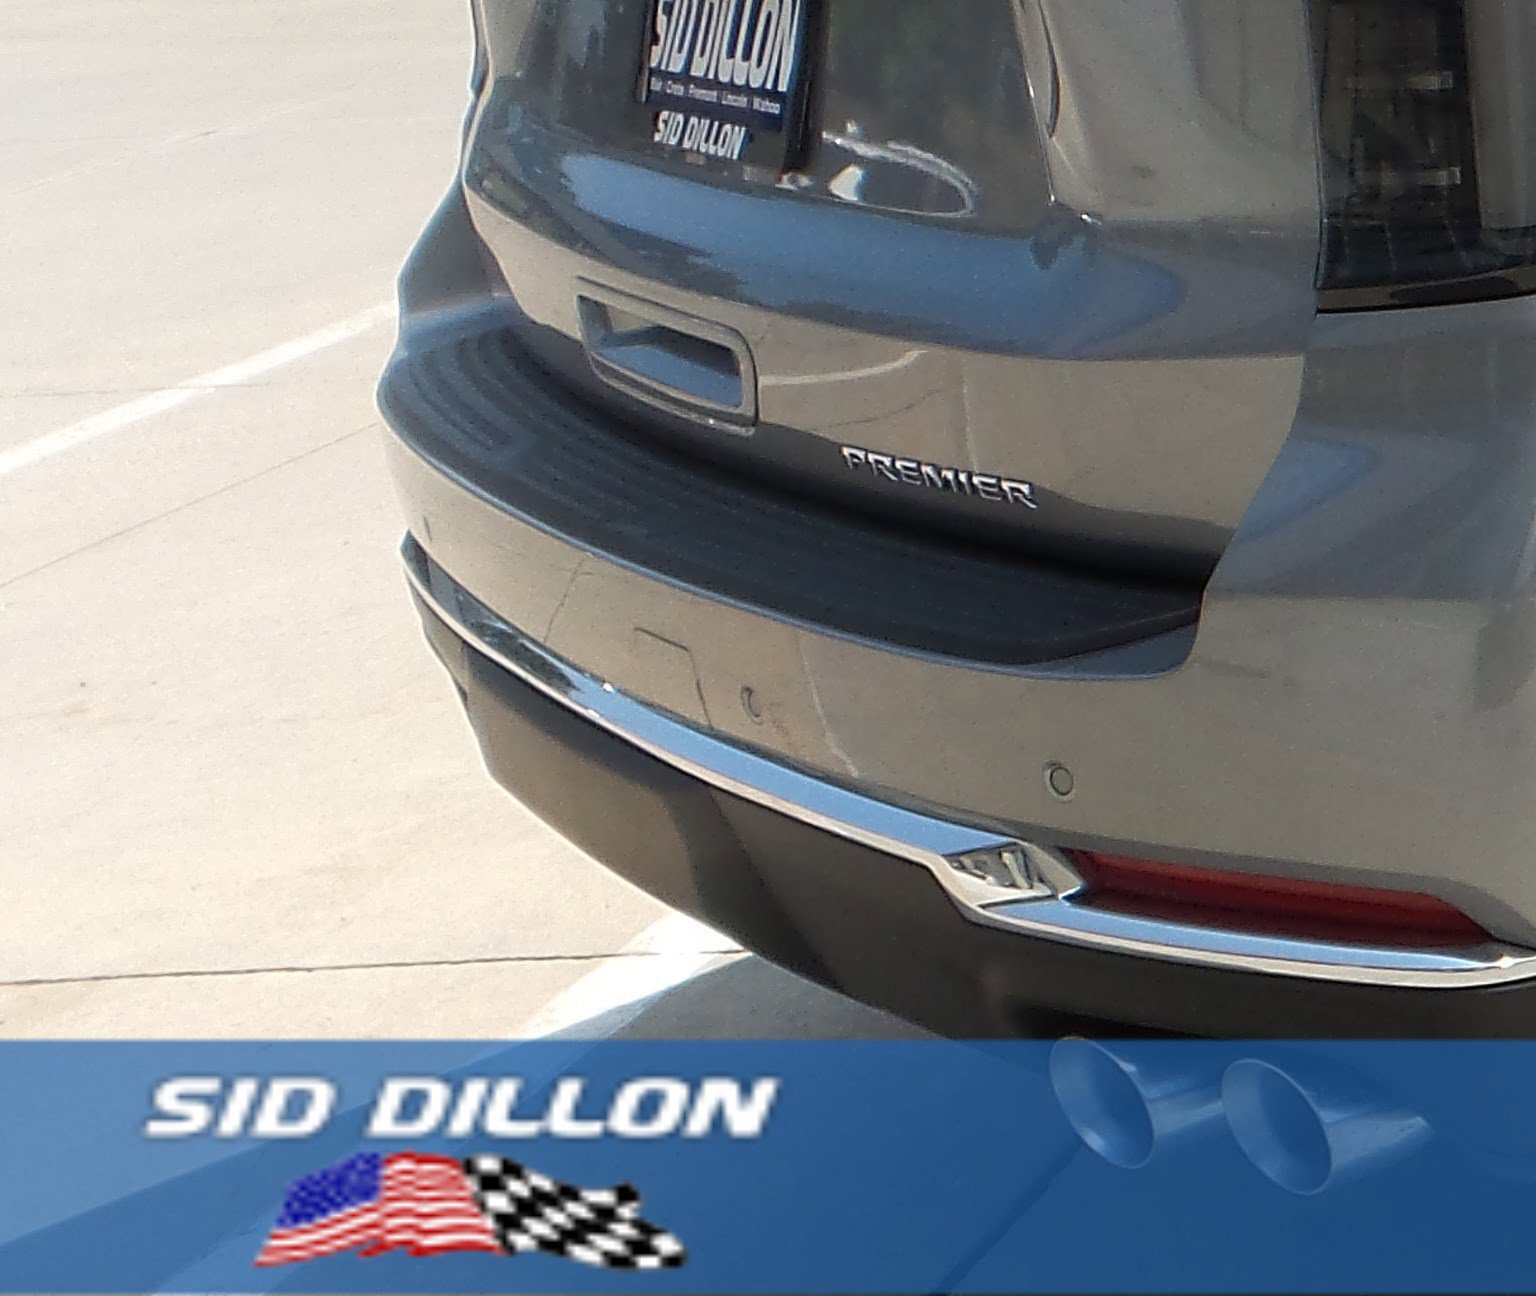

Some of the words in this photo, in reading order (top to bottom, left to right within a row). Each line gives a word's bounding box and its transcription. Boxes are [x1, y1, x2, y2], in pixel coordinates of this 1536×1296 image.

[653, 109, 684, 146] SID
[682, 115, 748, 161] DILLON
[840, 445, 1038, 509] PREMIER
